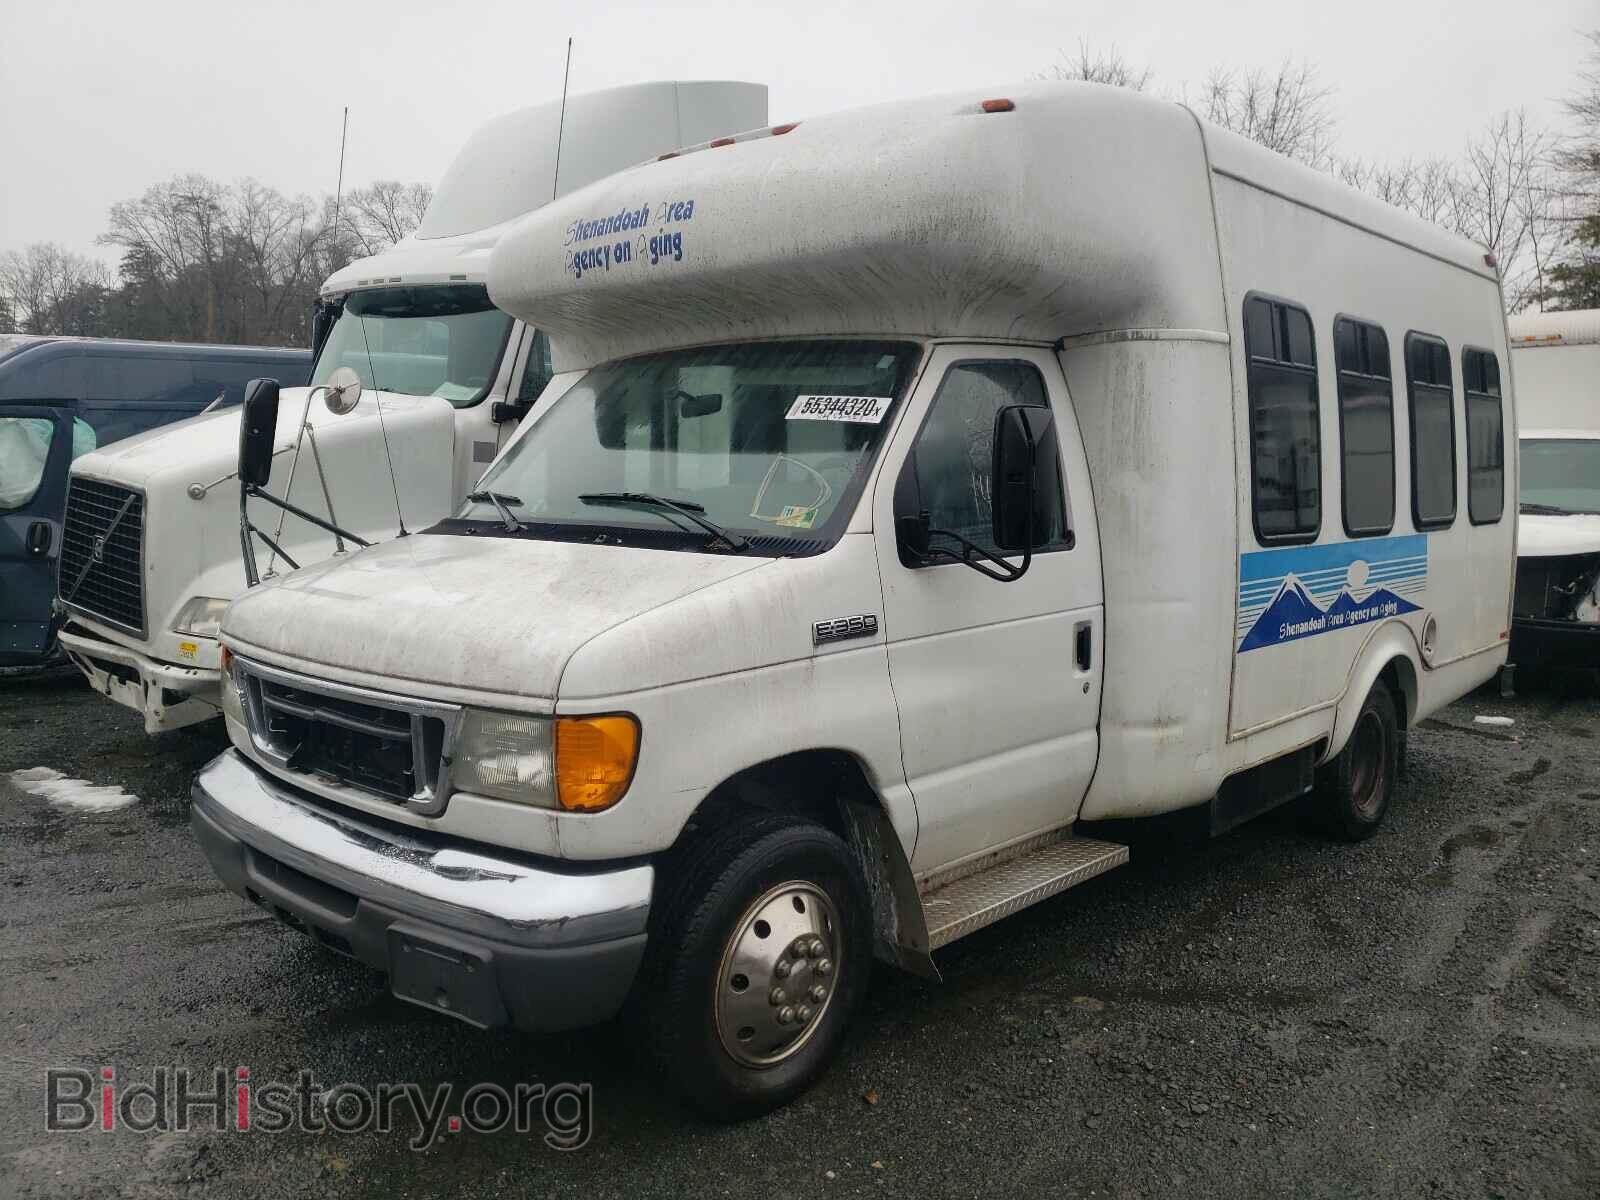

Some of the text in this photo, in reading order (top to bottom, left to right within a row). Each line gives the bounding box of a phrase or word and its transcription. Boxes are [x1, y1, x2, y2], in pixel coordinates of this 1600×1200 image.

[564, 200, 694, 246] Shenandoah Area
[564, 228, 682, 278] Agency on Aging
[1279, 615, 1326, 639] Shenandoah
[1345, 608, 1370, 625] Agency
[1370, 605, 1379, 617] on
